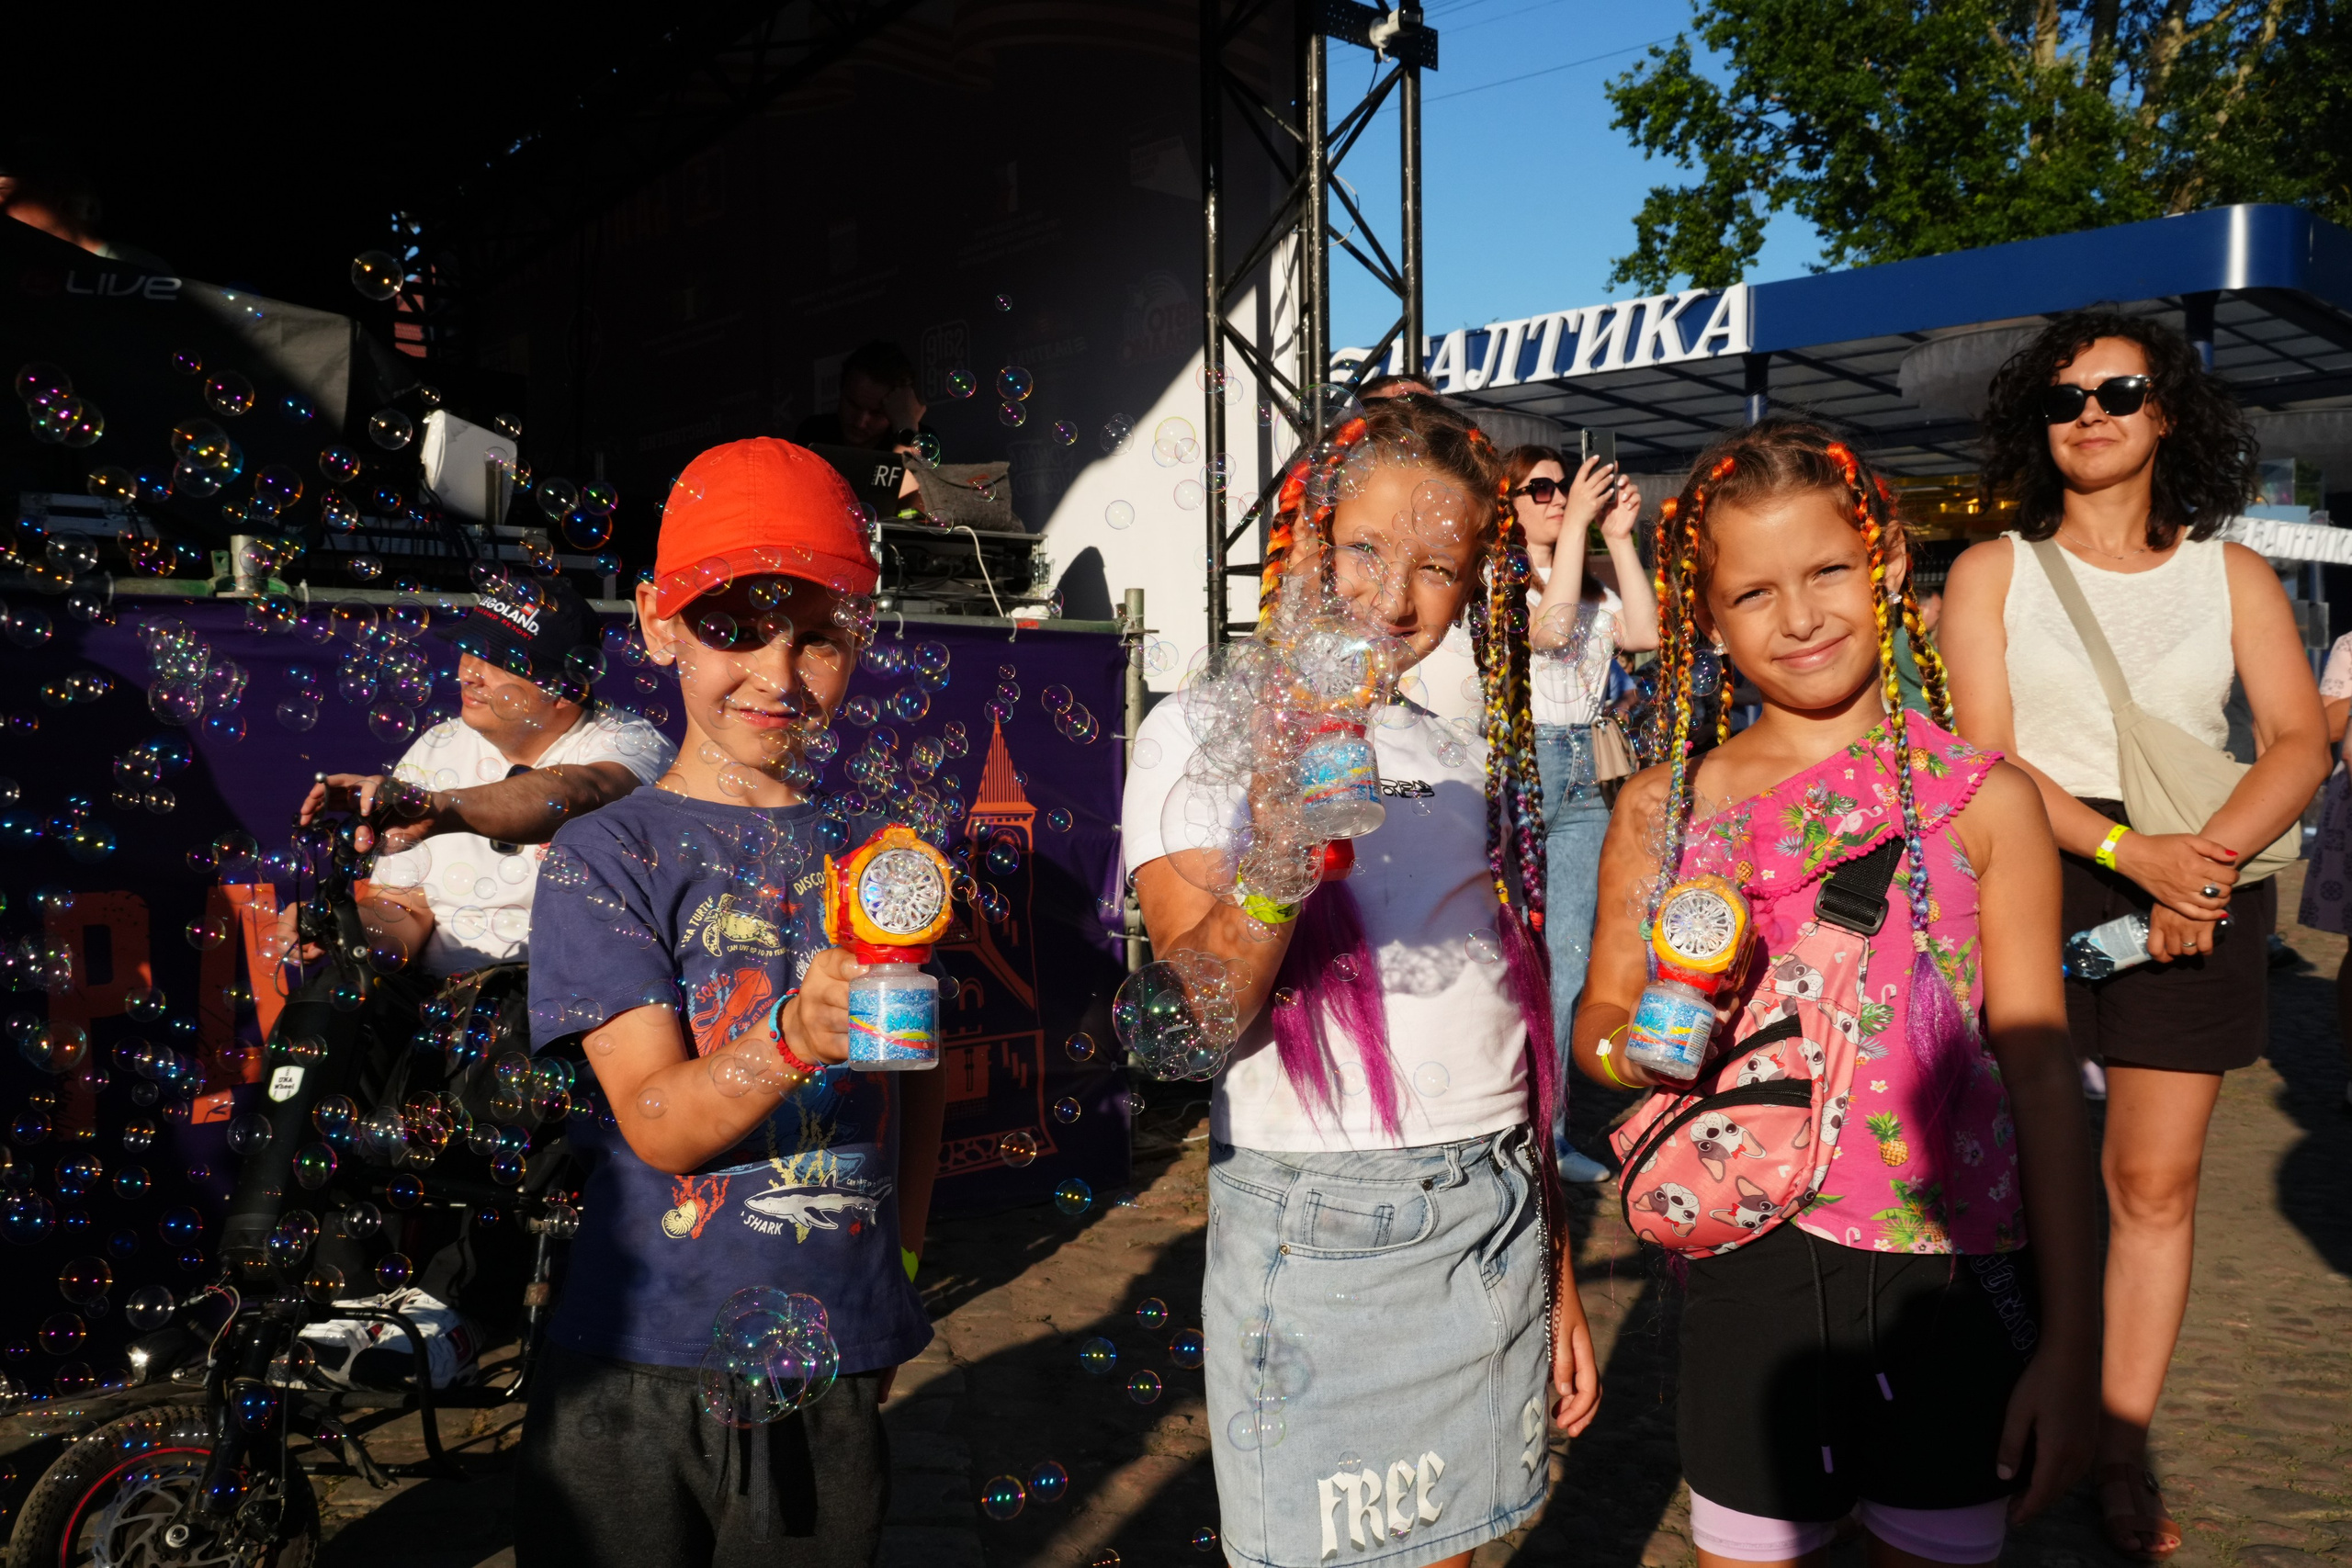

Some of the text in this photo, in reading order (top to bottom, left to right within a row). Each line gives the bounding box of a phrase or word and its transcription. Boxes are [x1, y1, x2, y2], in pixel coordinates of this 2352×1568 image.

[875, 465, 902, 487] RF
[502, 618, 533, 641] RESORT
[793, 872, 826, 896] DISCO
[682, 895, 714, 944] SEA TURTLE
[727, 944, 738, 953] CAN
[695, 974, 730, 1004] SQUID
[751, 1013, 761, 1024] JET
[743, 1214, 784, 1235] SHARK
[1316, 1450, 1446, 1563] FREE
